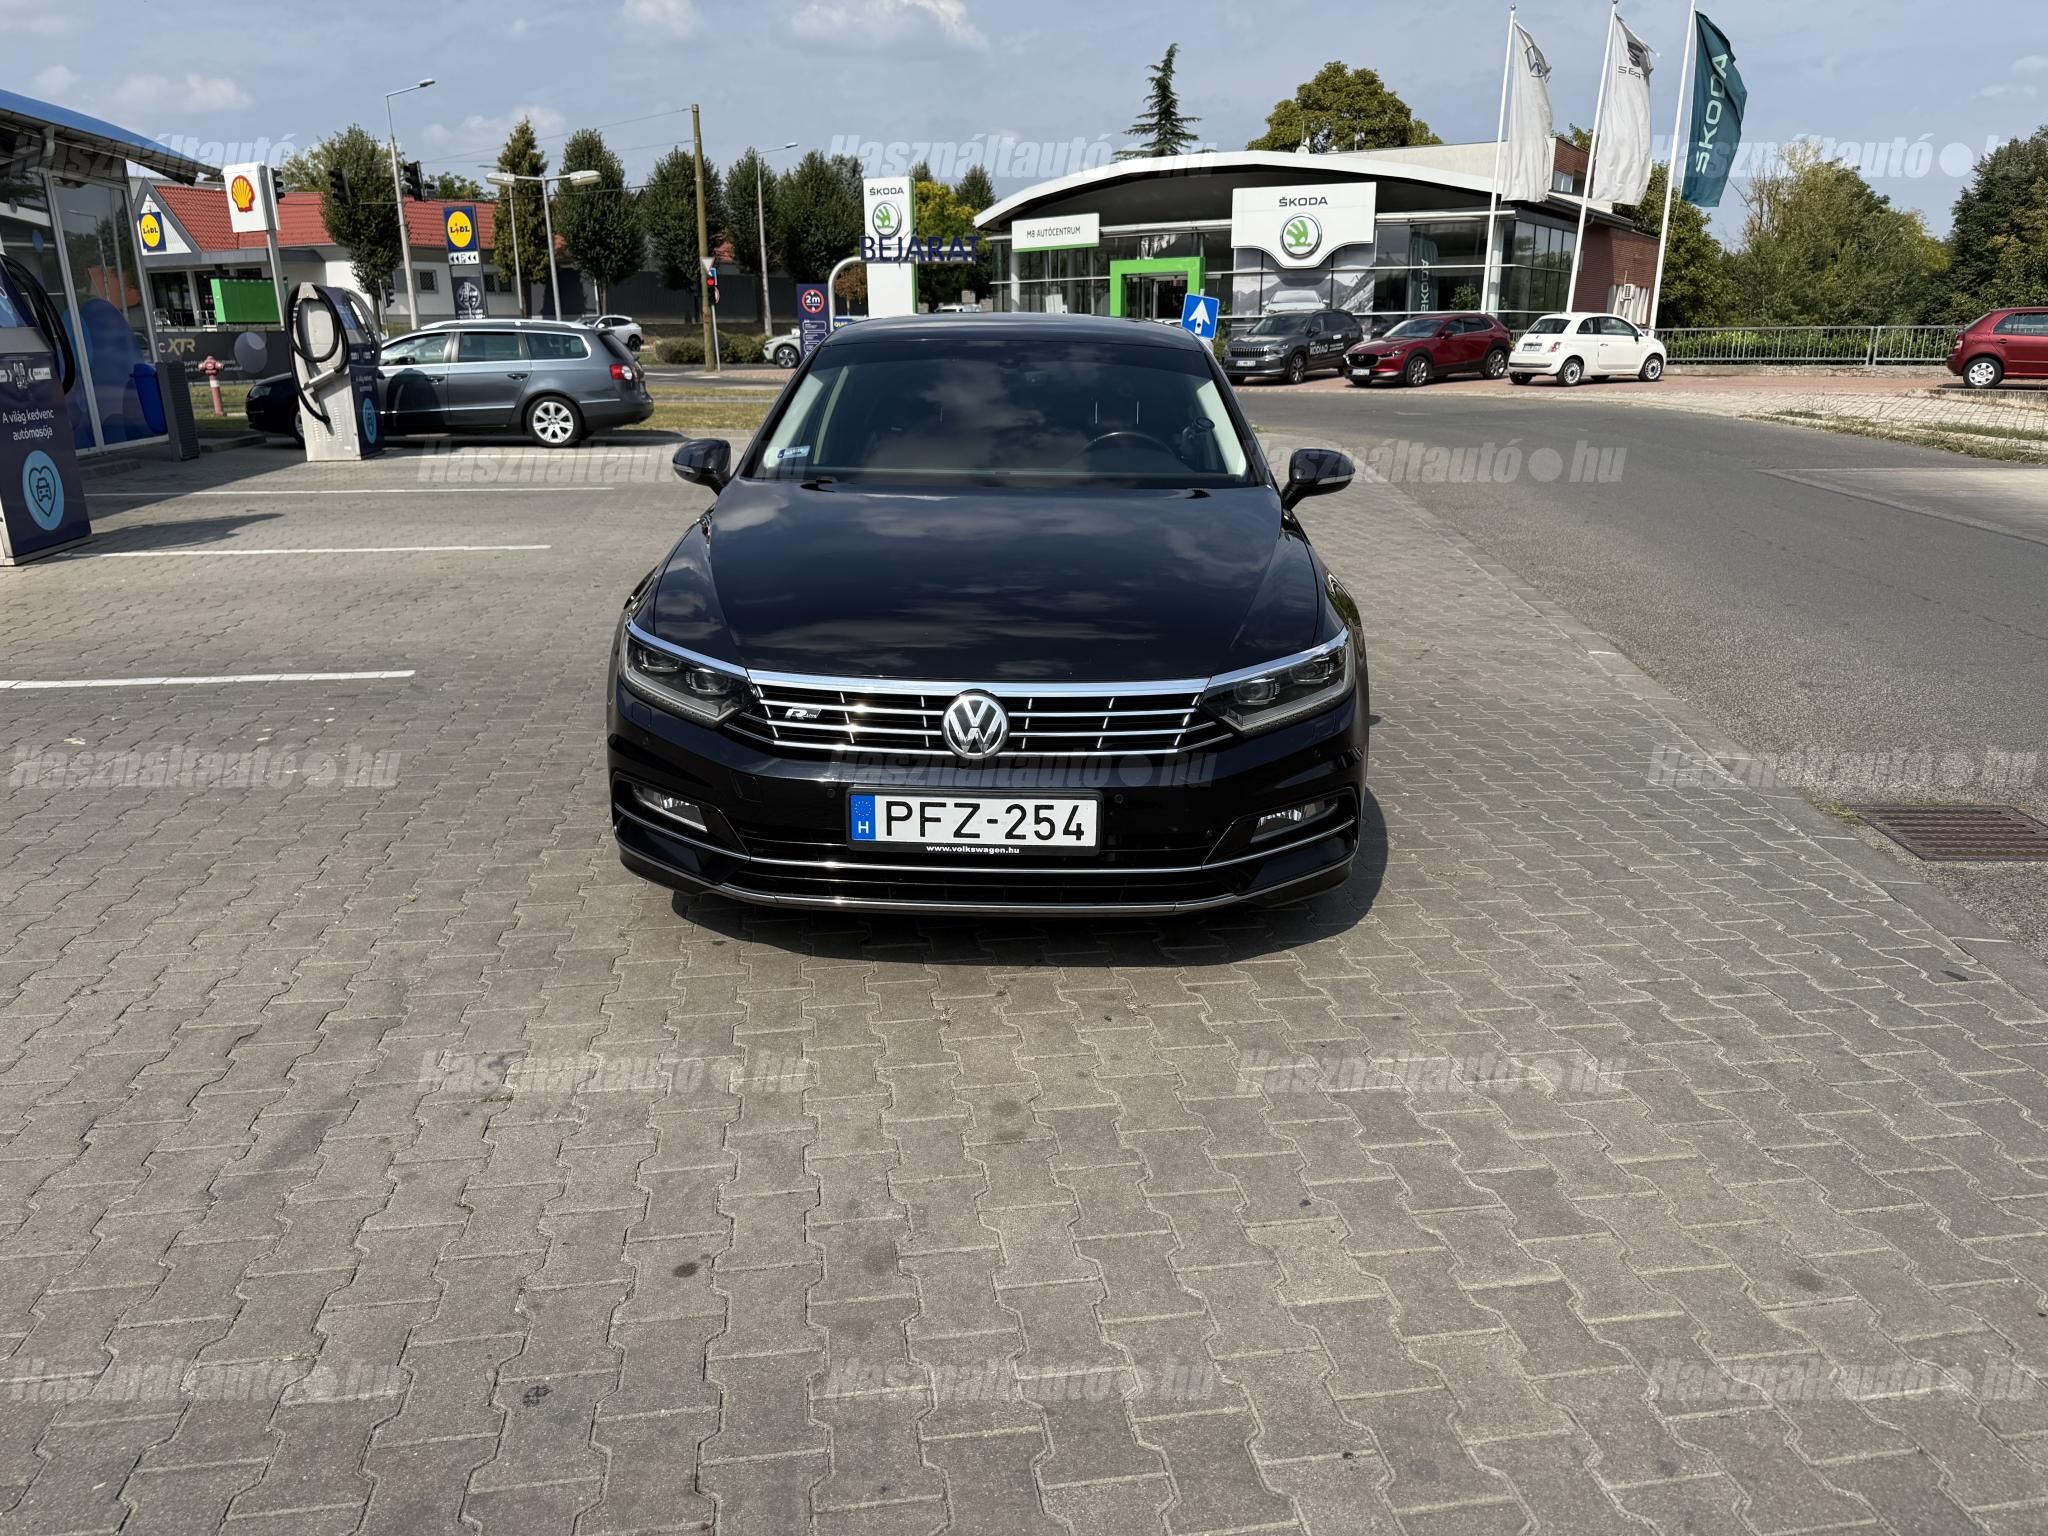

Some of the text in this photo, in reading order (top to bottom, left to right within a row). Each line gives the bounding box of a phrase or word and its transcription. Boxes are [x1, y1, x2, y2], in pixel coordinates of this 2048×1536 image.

[1278, 196, 1328, 207] ŠKODA
[2, 412, 9, 424] A
[26, 407, 55, 421] kedvenc
[858, 820, 869, 834] H
[885, 800, 1085, 842] PFZ-254
[926, 844, 1020, 855] www.volkswagen.hu
